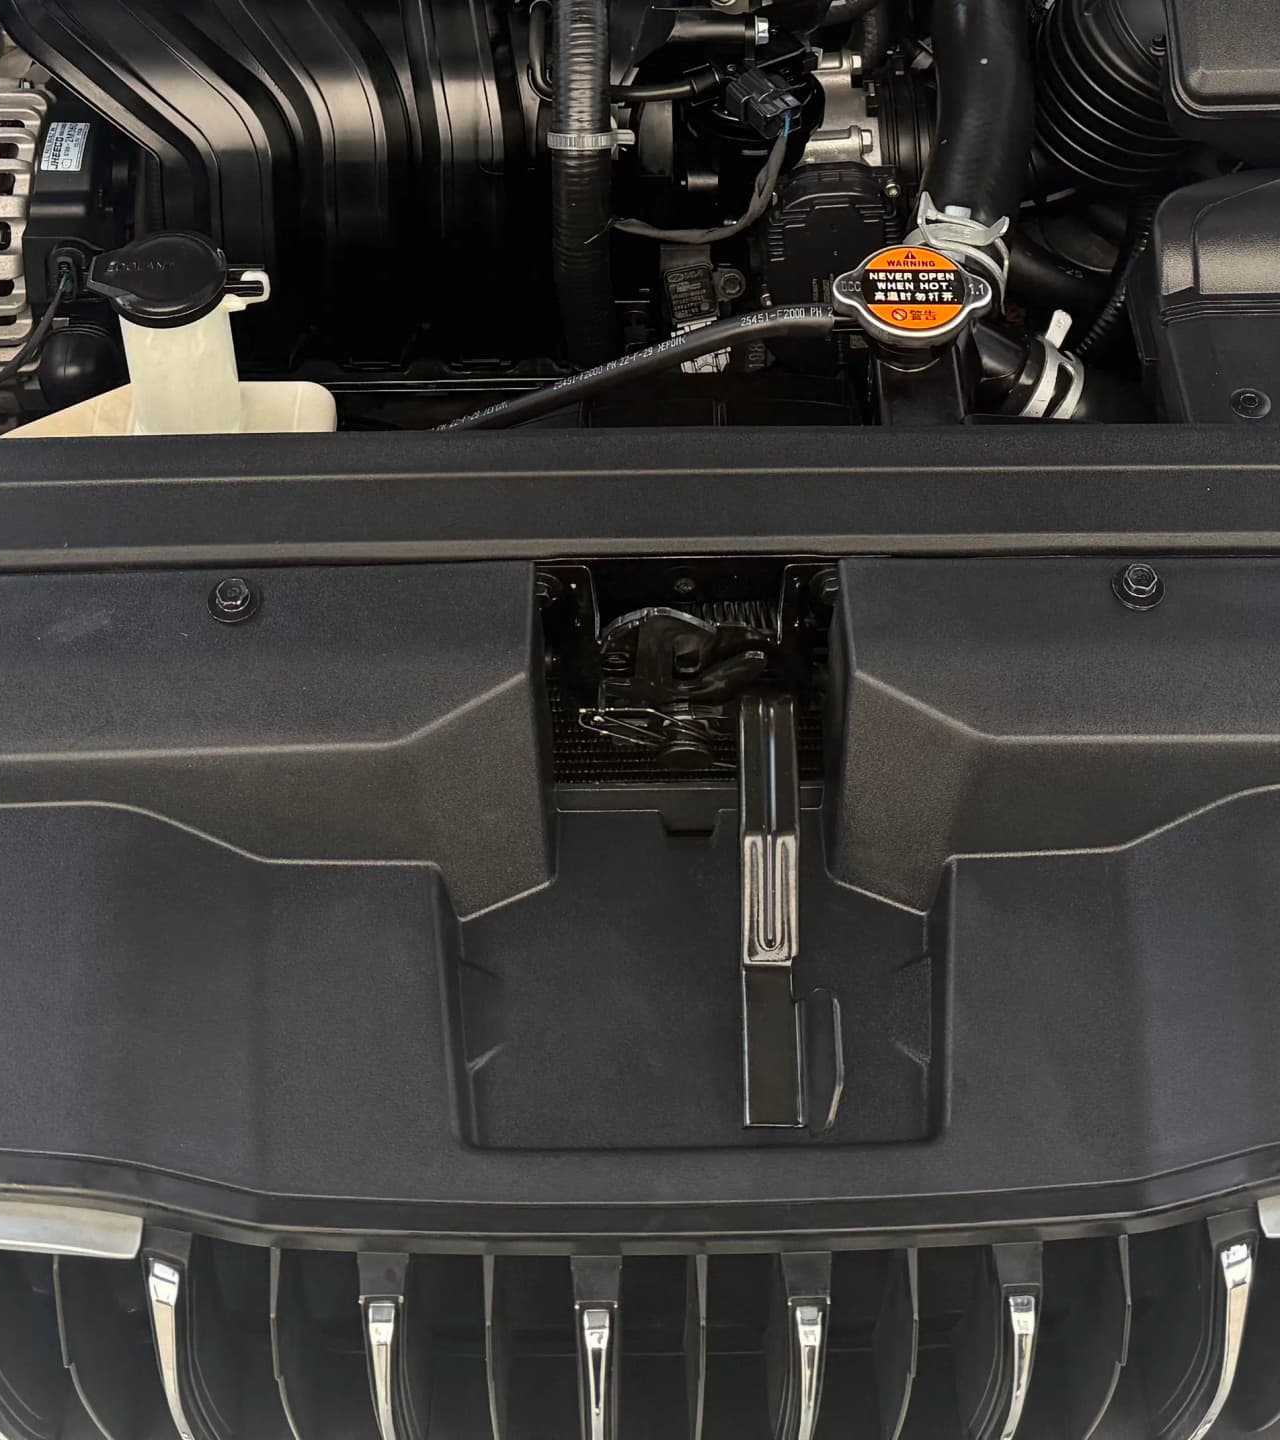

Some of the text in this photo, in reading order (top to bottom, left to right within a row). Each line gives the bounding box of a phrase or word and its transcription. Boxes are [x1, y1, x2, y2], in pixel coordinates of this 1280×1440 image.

[887, 259, 936, 268] WARNING
[869, 272, 955, 281] NEVER OPEN
[876, 281, 953, 290] WHEN HOT.
[968, 283, 985, 295] 1.1
